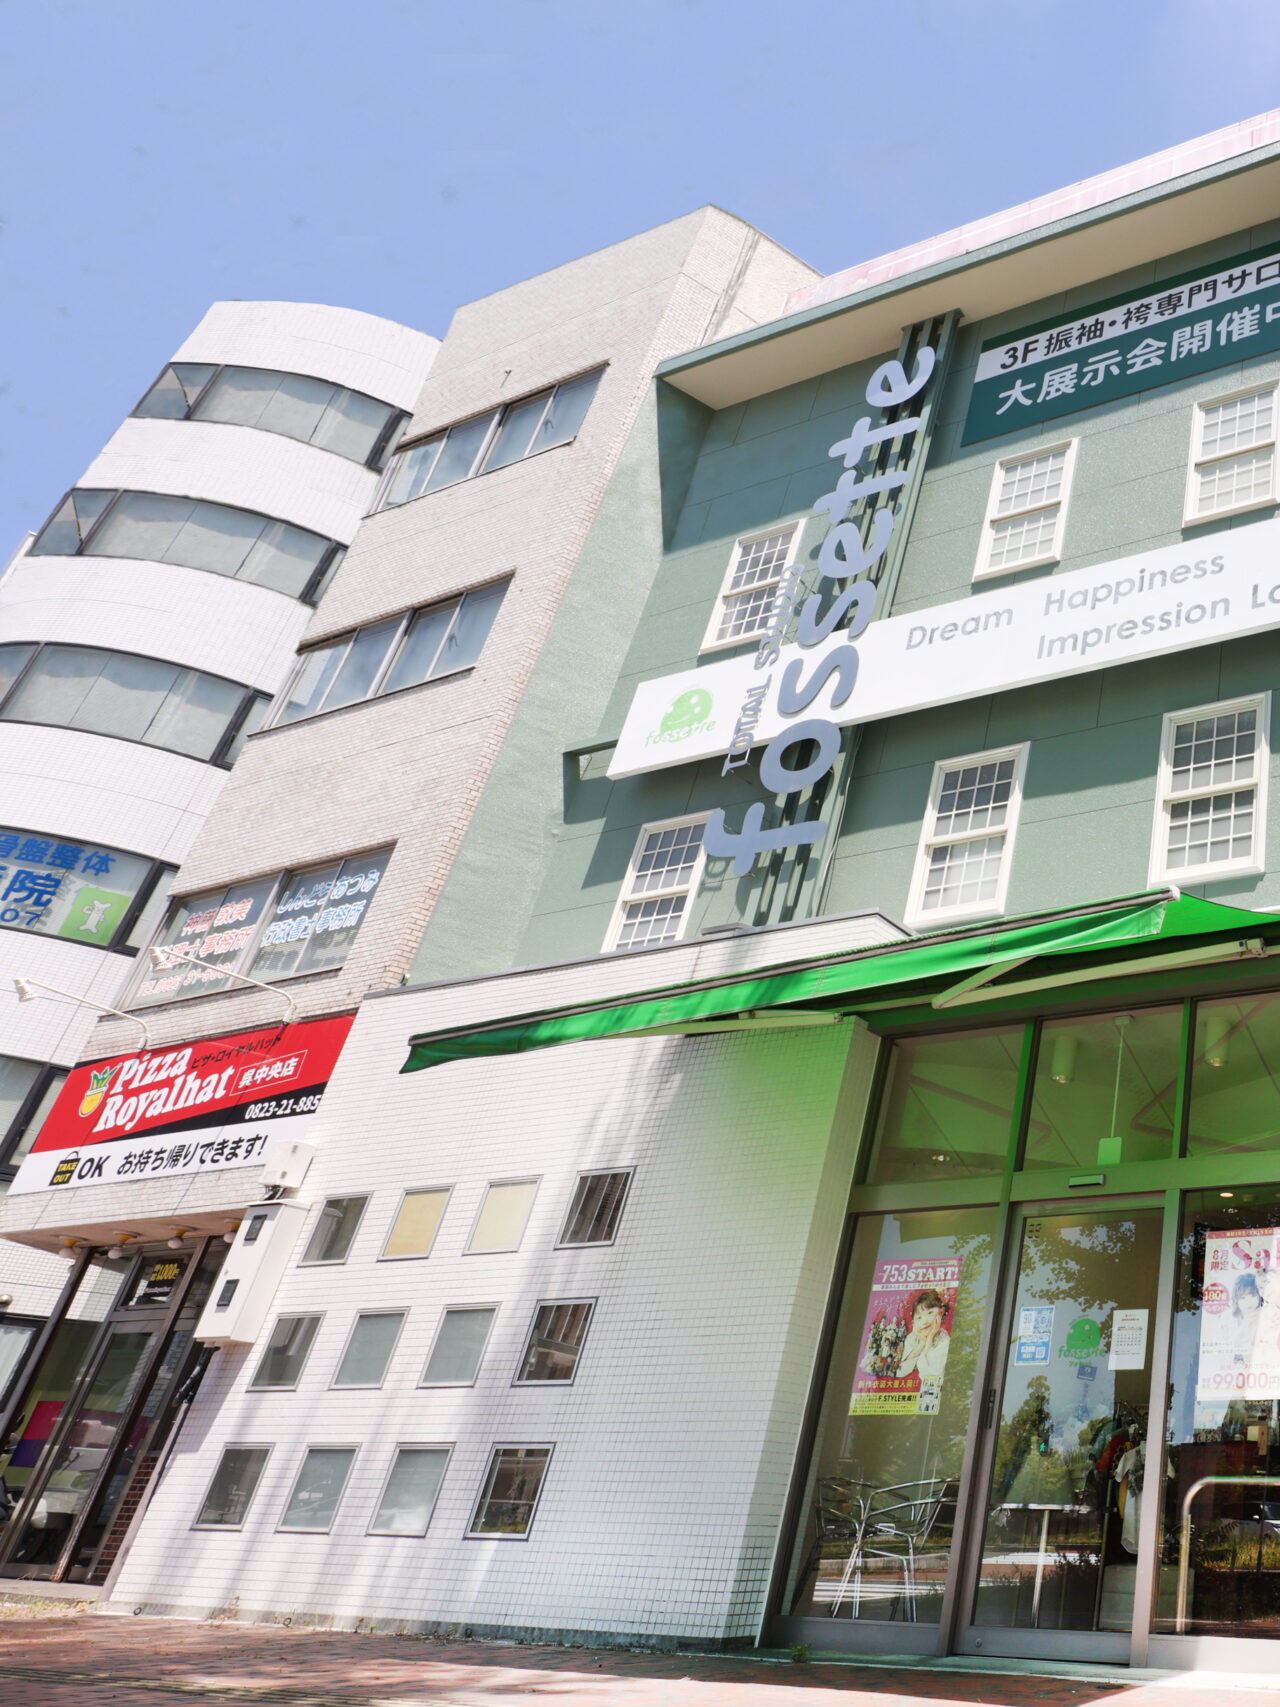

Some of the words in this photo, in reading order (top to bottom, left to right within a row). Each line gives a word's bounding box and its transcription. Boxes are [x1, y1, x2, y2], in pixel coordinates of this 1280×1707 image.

[702, 346, 937, 877] fossette
[905, 608, 1014, 651] Dream
[1043, 552, 1226, 618] Happiness
[1036, 594, 1231, 660] Impression
[644, 719, 717, 749] fossette
[0, 832, 116, 877] 骨盤整体
[0, 864, 62, 907] 院
[259, 898, 370, 949] 行政書士事務所
[112, 1047, 194, 1095] Pizza
[237, 1056, 300, 1089] 呉中央店
[92, 1065, 236, 1134] Royalhat
[58, 1161, 79, 1173] TAKE
[77, 1154, 112, 1180] OK
[116, 1133, 269, 1176] お持ち帰りできます!
[52, 1173, 71, 1184] OUT
[1210, 1260, 1230, 1271] 限定
[1212, 1249, 1229, 1261] 8月
